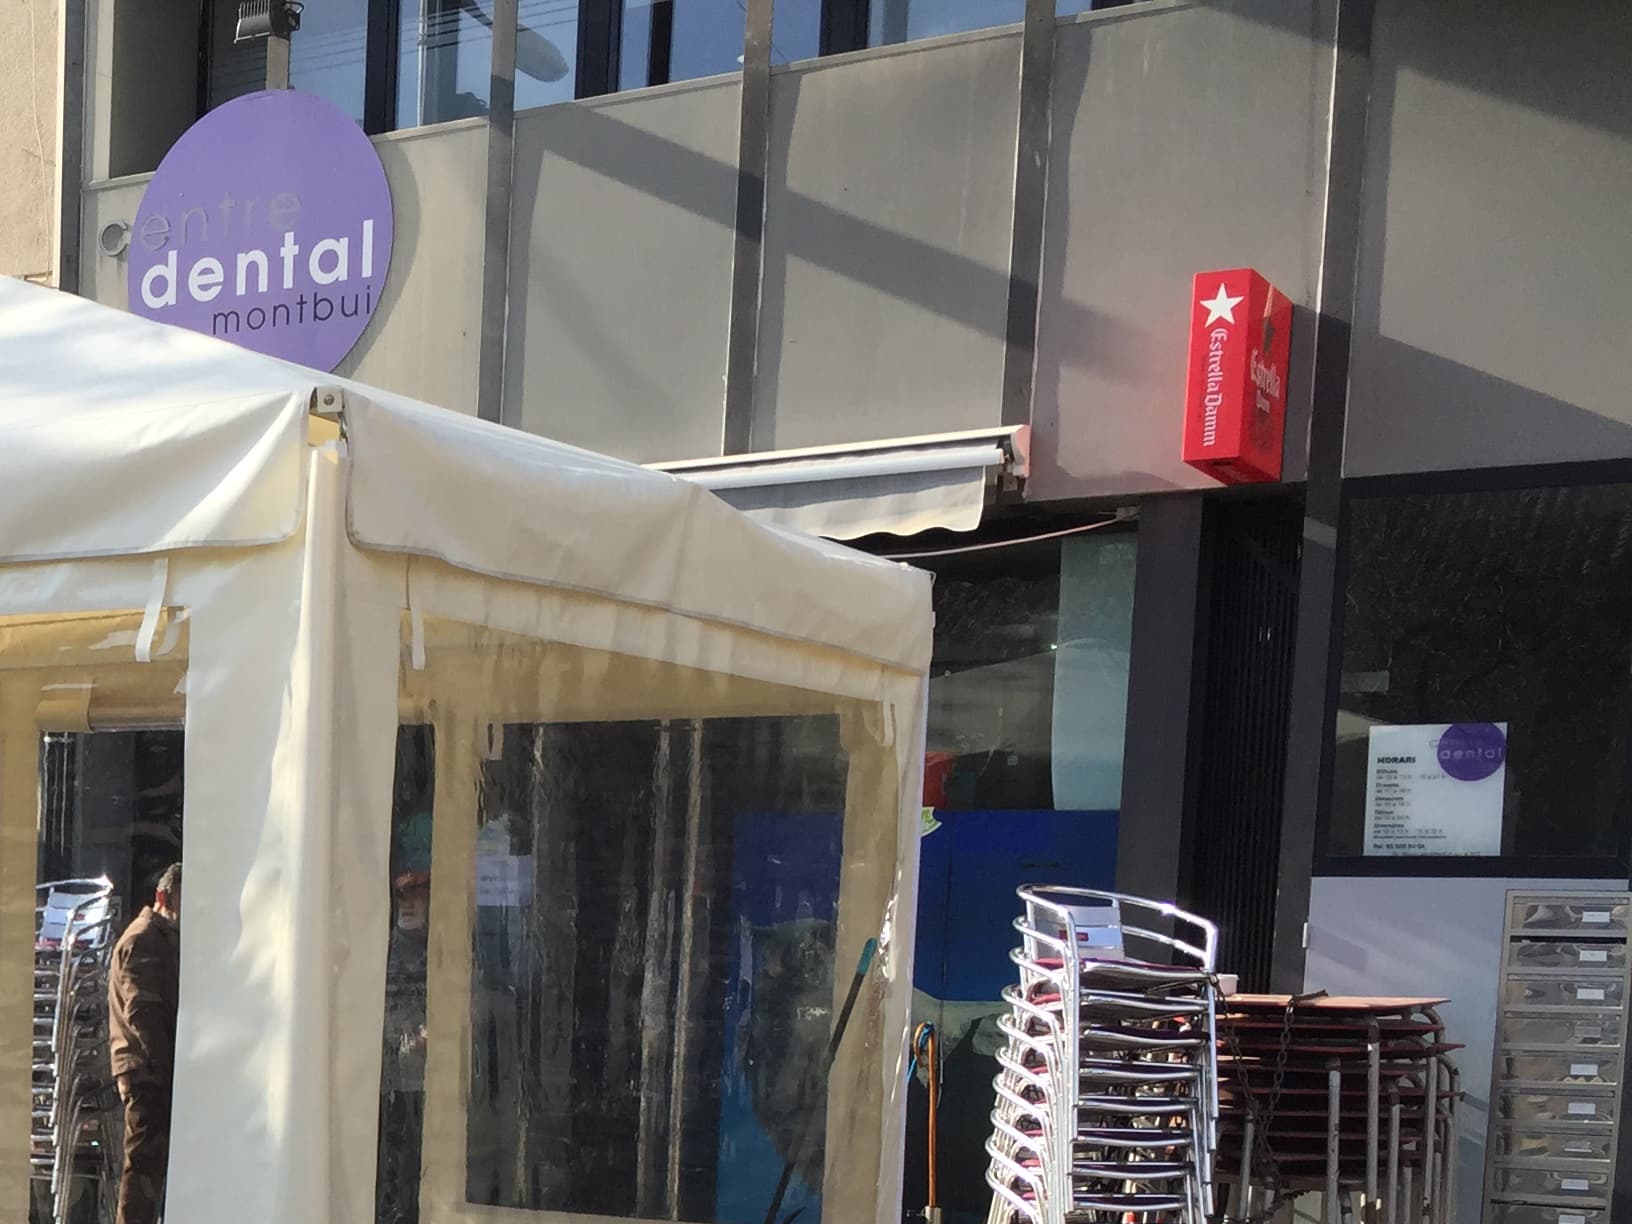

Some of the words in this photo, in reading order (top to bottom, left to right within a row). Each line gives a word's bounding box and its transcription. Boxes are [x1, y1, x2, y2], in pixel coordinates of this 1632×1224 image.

[99, 192, 302, 257] centre
[141, 219, 374, 310] dental
[212, 285, 371, 335] montbui
[1206, 327, 1229, 393] Estrella
[1202, 391, 1223, 446] Damm
